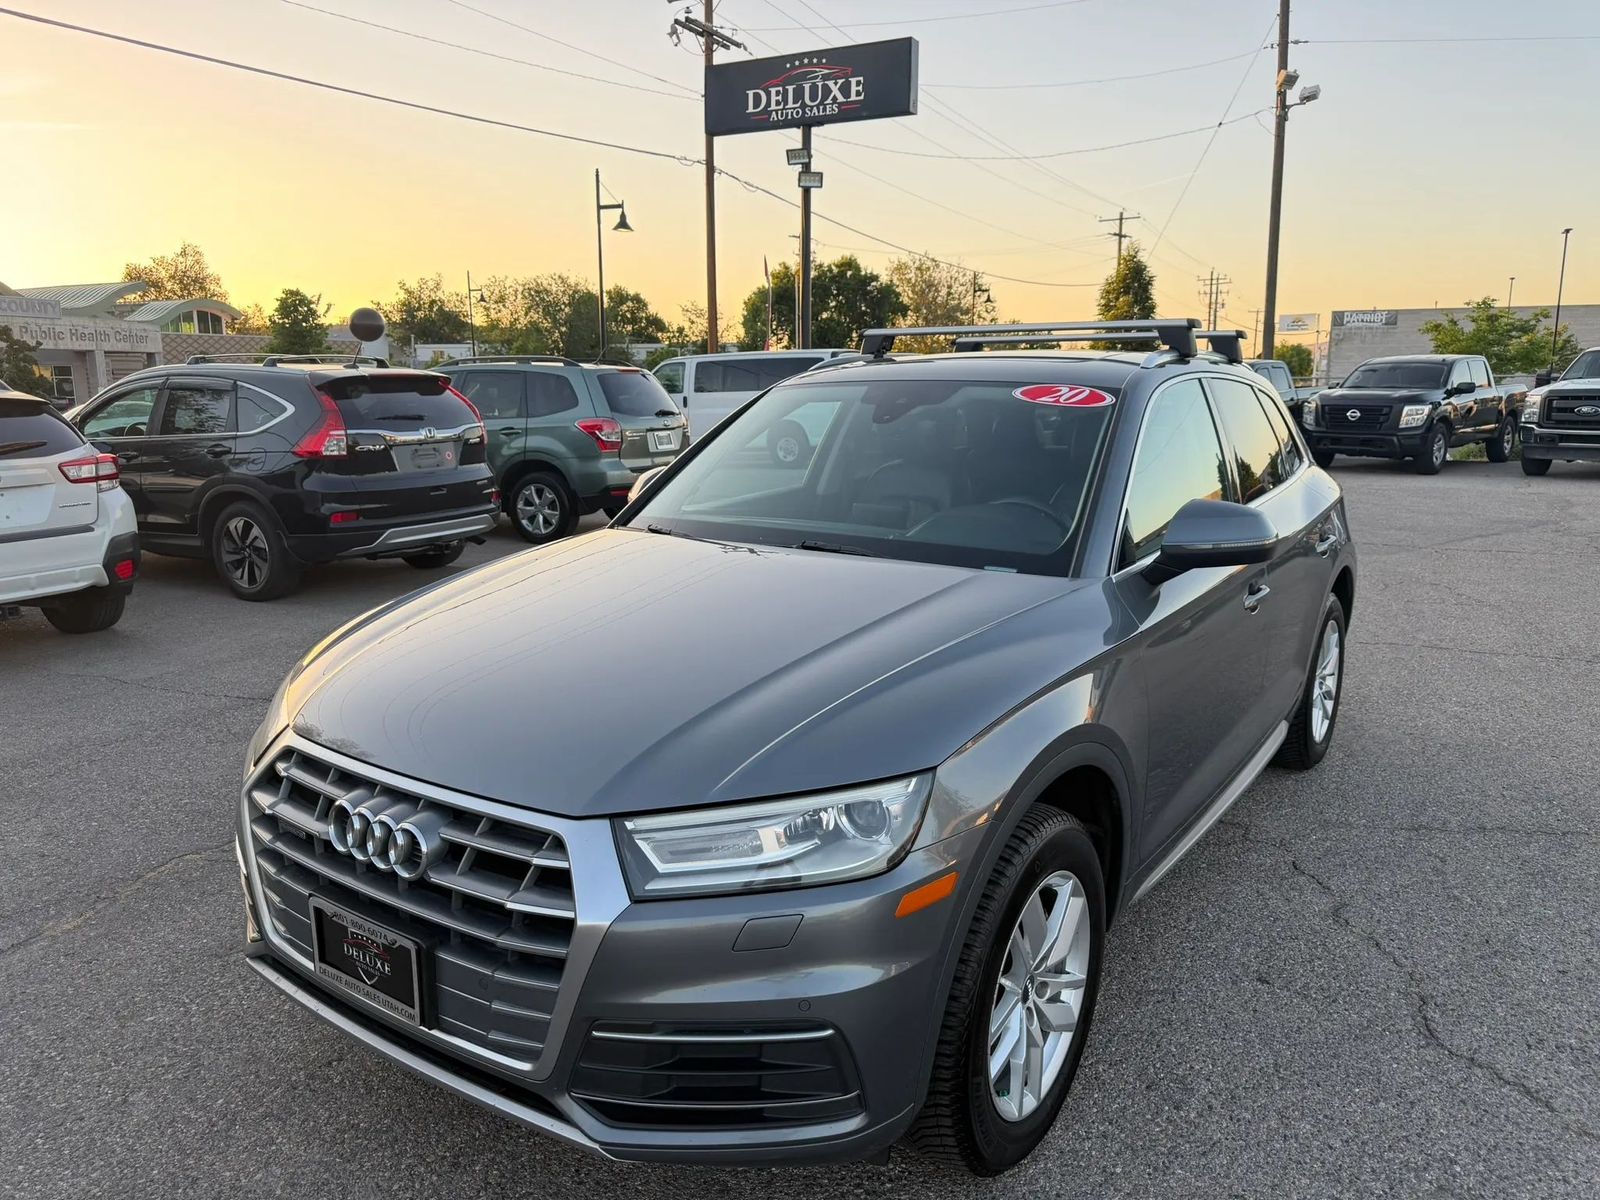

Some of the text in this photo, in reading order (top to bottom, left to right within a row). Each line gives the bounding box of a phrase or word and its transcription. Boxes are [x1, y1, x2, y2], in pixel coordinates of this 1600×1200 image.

[745, 76, 865, 113] DELUXE
[769, 103, 839, 122] AUTO SALES
[1343, 311, 1388, 325] PATRIOT
[18, 325, 149, 345] Public Health Center
[1035, 386, 1090, 404] 20
[343, 943, 392, 976] DELUXE
[319, 966, 416, 1023] DELUXE AUTO SALES UTAH.COM
